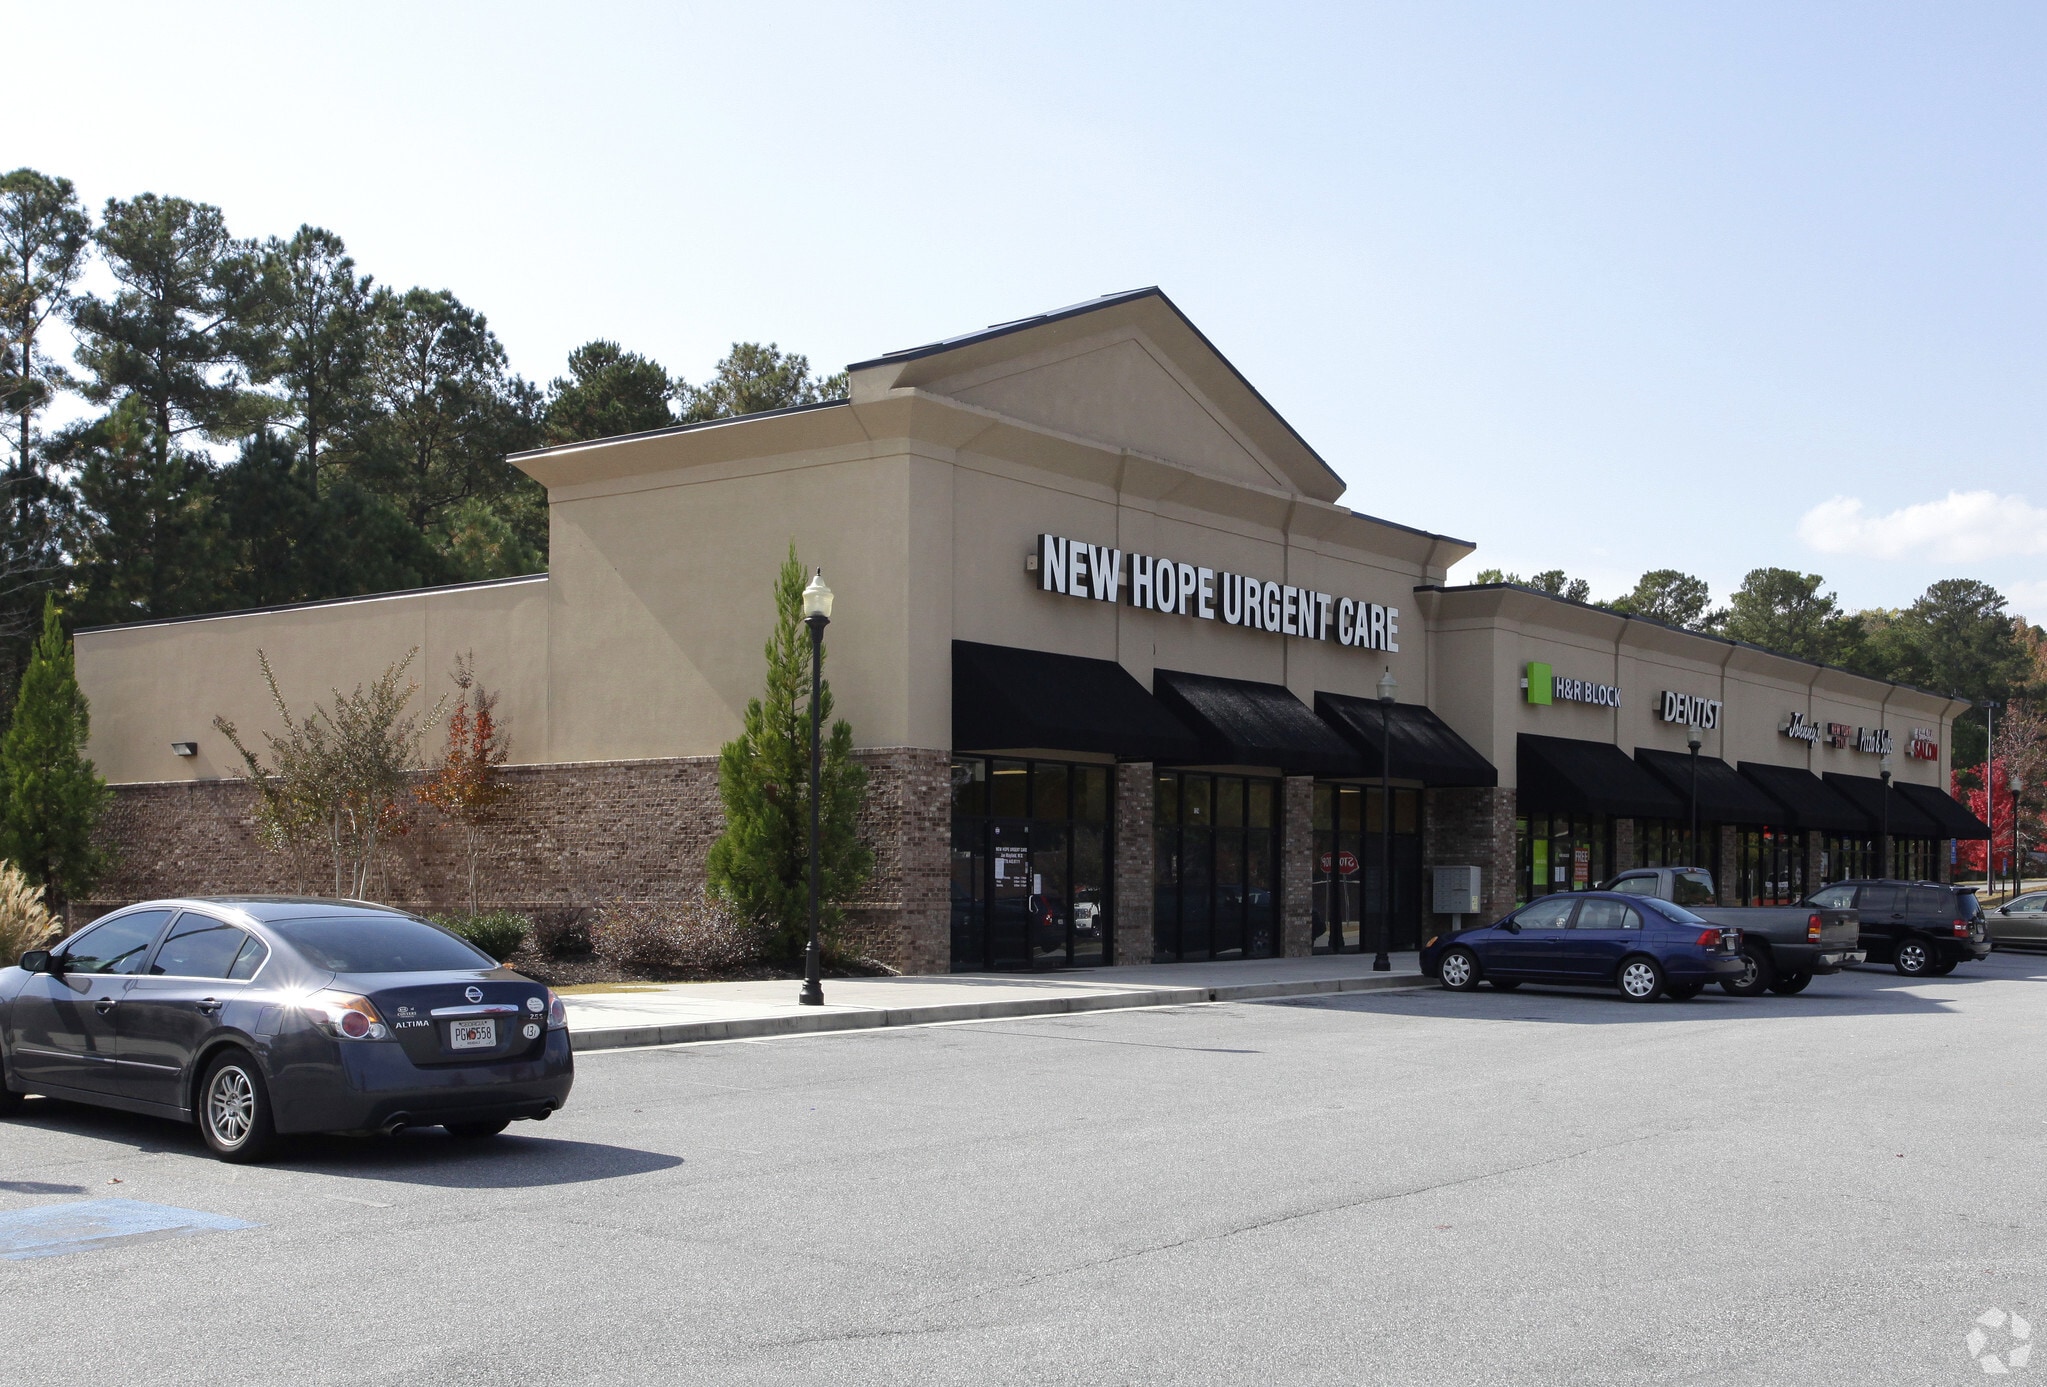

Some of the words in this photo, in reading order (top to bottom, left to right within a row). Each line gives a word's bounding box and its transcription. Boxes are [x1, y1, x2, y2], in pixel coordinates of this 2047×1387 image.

[1043, 534, 1120, 602] NEW
[1133, 553, 1215, 620] HOPE
[1223, 572, 1332, 641] URGENT
[1338, 597, 1399, 653] CARE
[1556, 676, 1581, 701] H&R
[1585, 681, 1622, 708] BLOCK
[1663, 691, 1722, 729] DENTIST
[1914, 739, 1938, 761] SALON
[1575, 850, 1588, 863] FREE
[395, 1020, 430, 1029] ALTIMA
